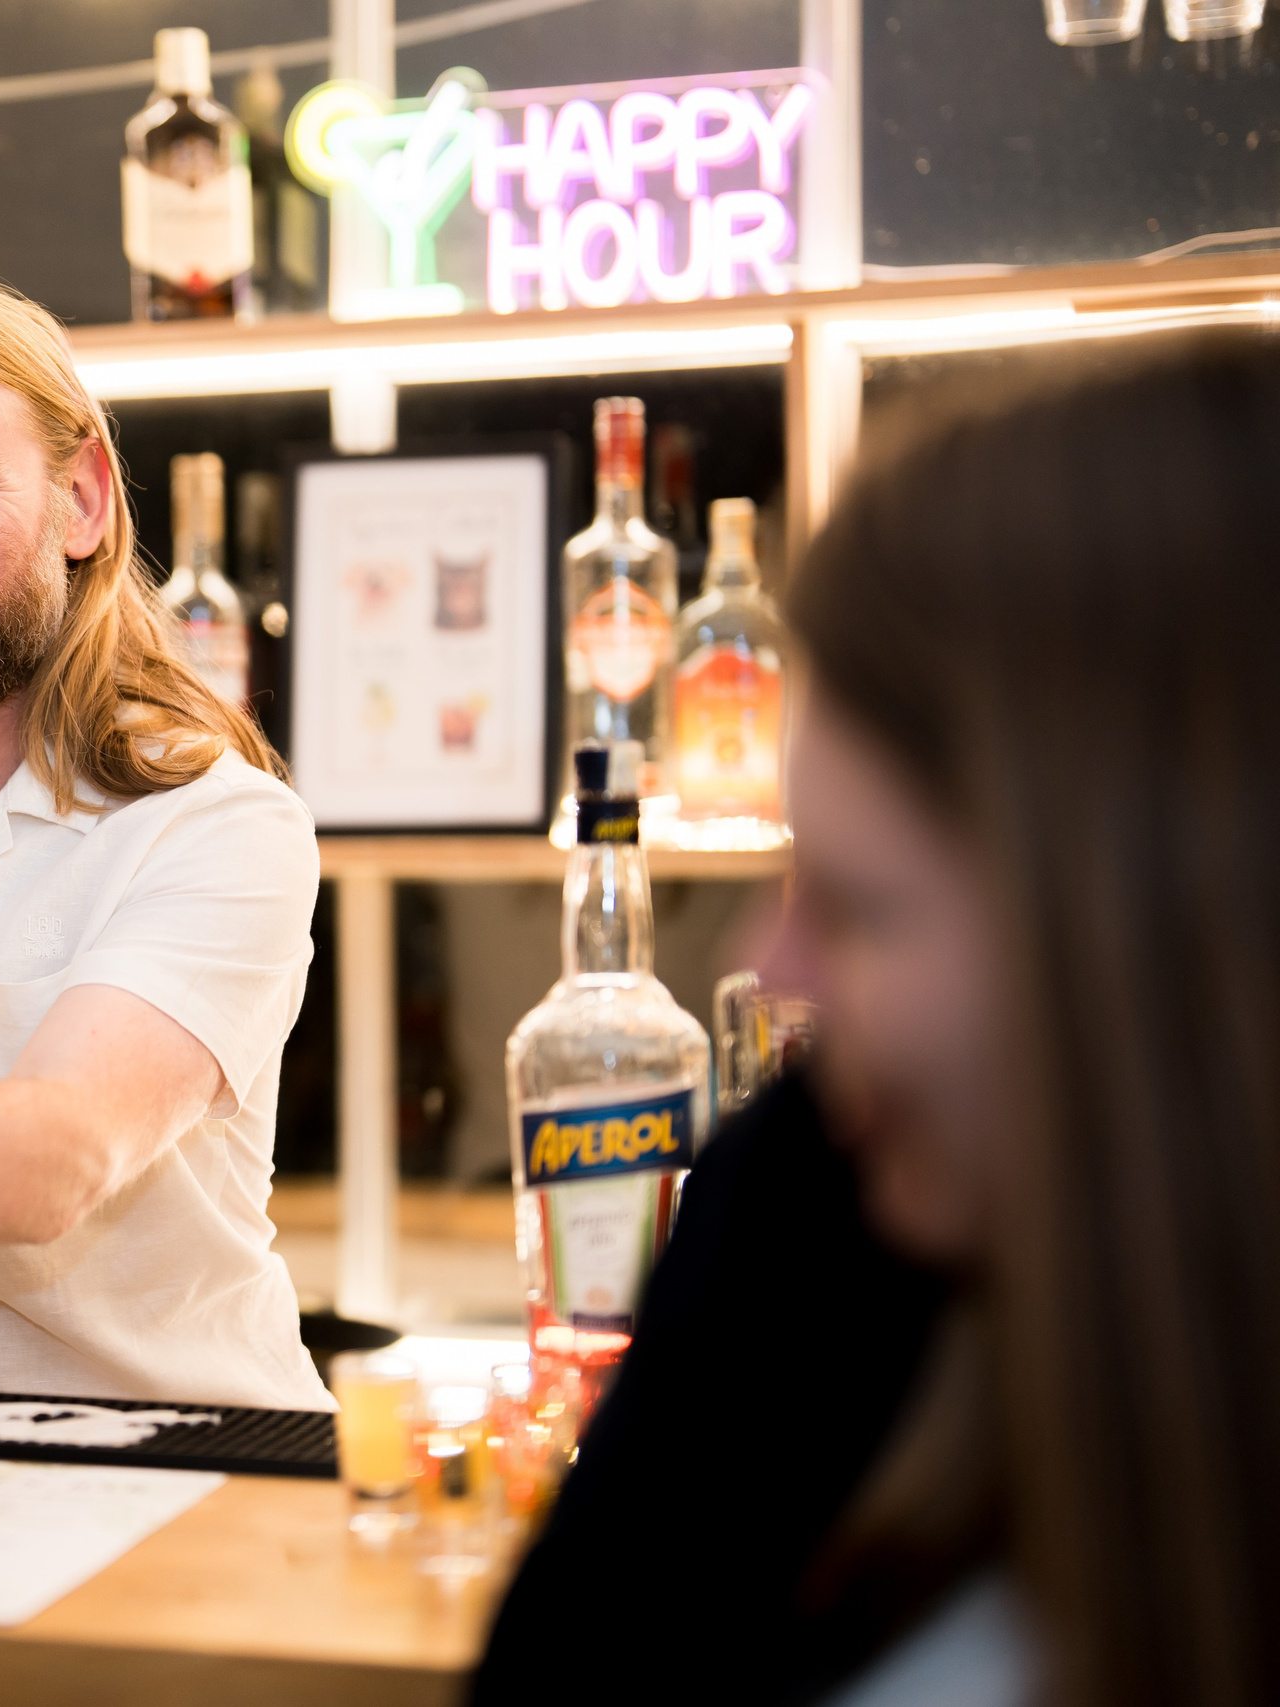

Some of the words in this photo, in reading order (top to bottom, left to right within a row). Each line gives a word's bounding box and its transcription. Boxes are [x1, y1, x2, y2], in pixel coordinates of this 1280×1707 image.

[473, 84, 813, 212] HAPPY
[488, 189, 794, 315] HOUR
[529, 1109, 680, 1177] APEROL
